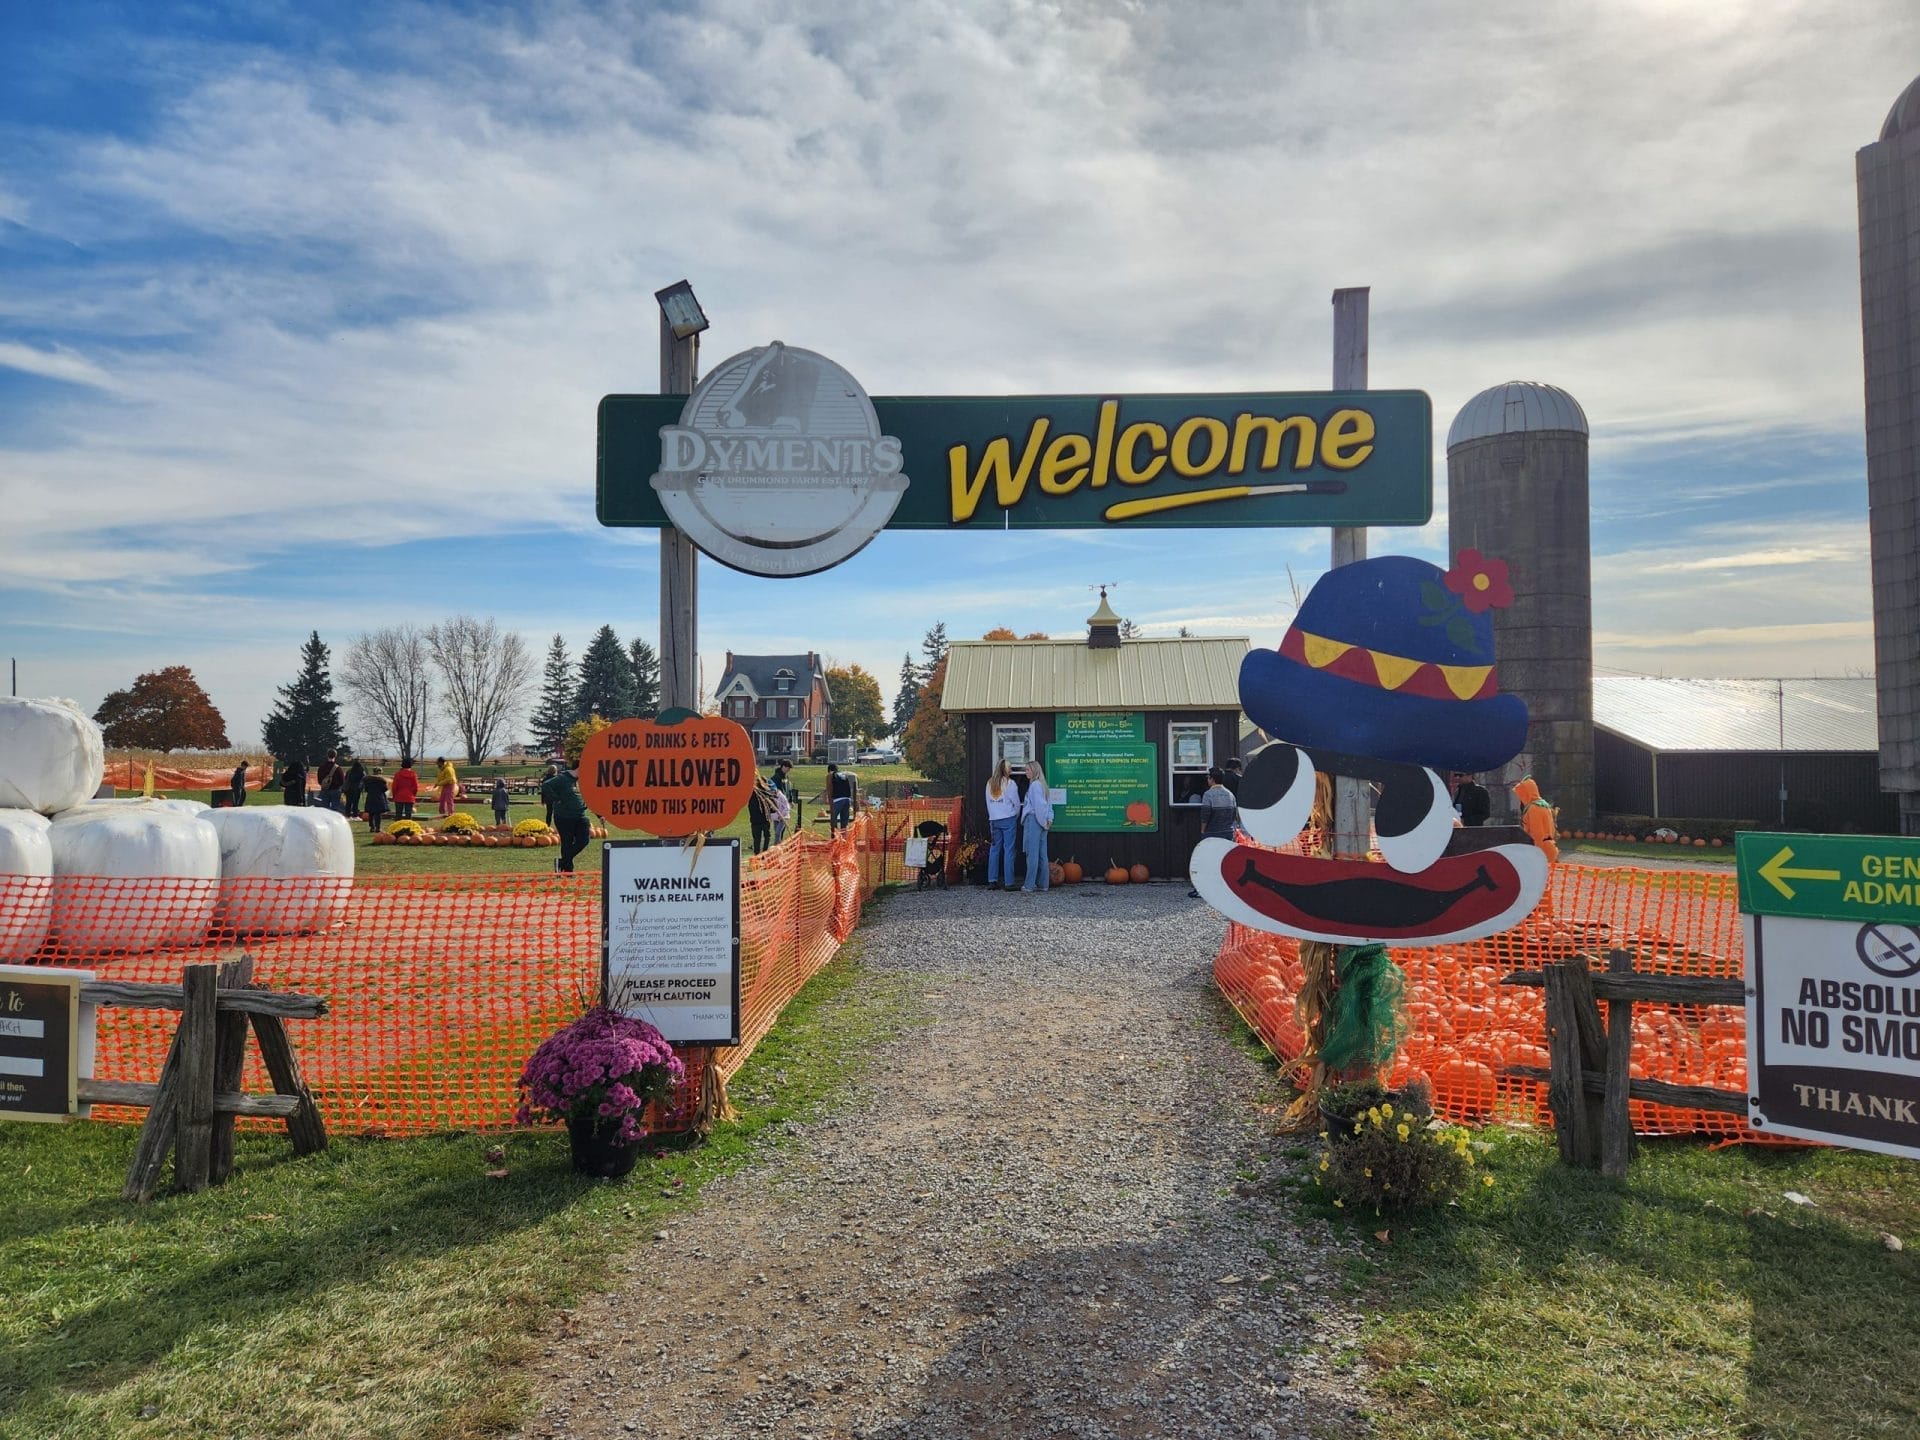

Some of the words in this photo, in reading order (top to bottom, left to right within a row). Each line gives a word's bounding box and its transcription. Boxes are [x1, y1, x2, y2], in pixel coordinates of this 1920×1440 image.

[948, 400, 1376, 523] Welcome
[727, 476, 789, 485] DRUMMOND
[791, 476, 819, 485] FARM
[845, 476, 869, 486] 1887
[750, 553, 782, 570] from
[786, 554, 807, 569] the
[1068, 720, 1095, 729] OPEN
[607, 733, 641, 751] FOOD,
[645, 732, 688, 749] DRINKS
[690, 732, 699, 748] &
[703, 732, 730, 748] PETS
[596, 758, 639, 788] NOT
[644, 758, 741, 787] ALLOWED
[611, 798, 658, 815] BEYOND
[662, 798, 687, 815] THIS
[691, 798, 726, 814] POINT
[633, 877, 711, 890] WARNING
[620, 894, 644, 903] THIS
[646, 894, 656, 903] IS
[658, 894, 666, 902] A
[667, 893, 694, 902] REAL
[696, 893, 724, 901] FARM
[627, 979, 666, 989] PLEASE
[668, 978, 717, 988] PROCEED
[8, 990, 24, 1012] to
[632, 992, 661, 1001] WITH
[663, 991, 711, 1001] CAUTION
[1799, 977, 1920, 1018] ABSOLU
[1781, 1007, 1830, 1049] NO
[1842, 1014, 1920, 1062] SMO
[7, 1081, 27, 1092] then.
[1792, 1083, 1919, 1125] THANK
